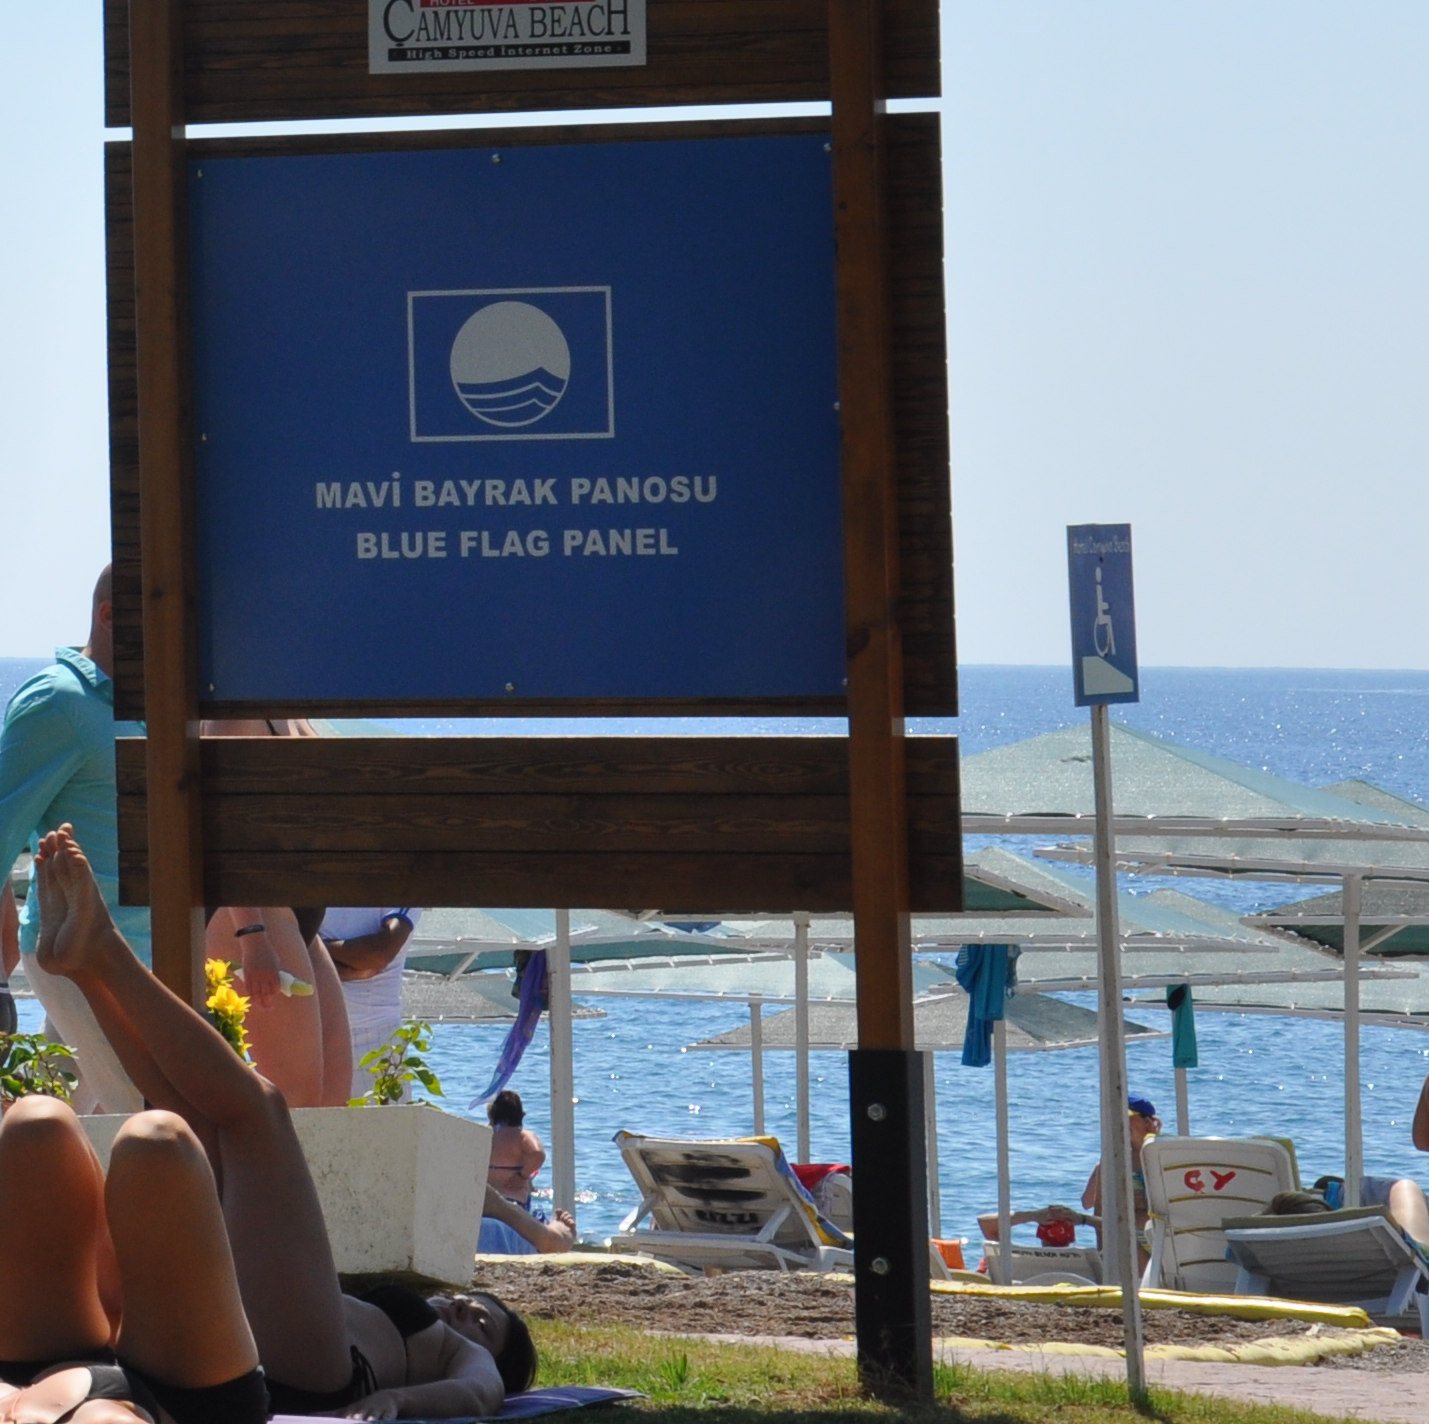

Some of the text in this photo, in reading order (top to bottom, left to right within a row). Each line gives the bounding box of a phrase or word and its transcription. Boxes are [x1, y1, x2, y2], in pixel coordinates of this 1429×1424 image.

[406, 48, 443, 61] High
[448, 46, 496, 60] Speed
[573, 44, 612, 54] Zone
[316, 471, 718, 509] MAVİ BAYRAK PANOSU
[356, 528, 679, 560] BLUE FLAG PANEL
